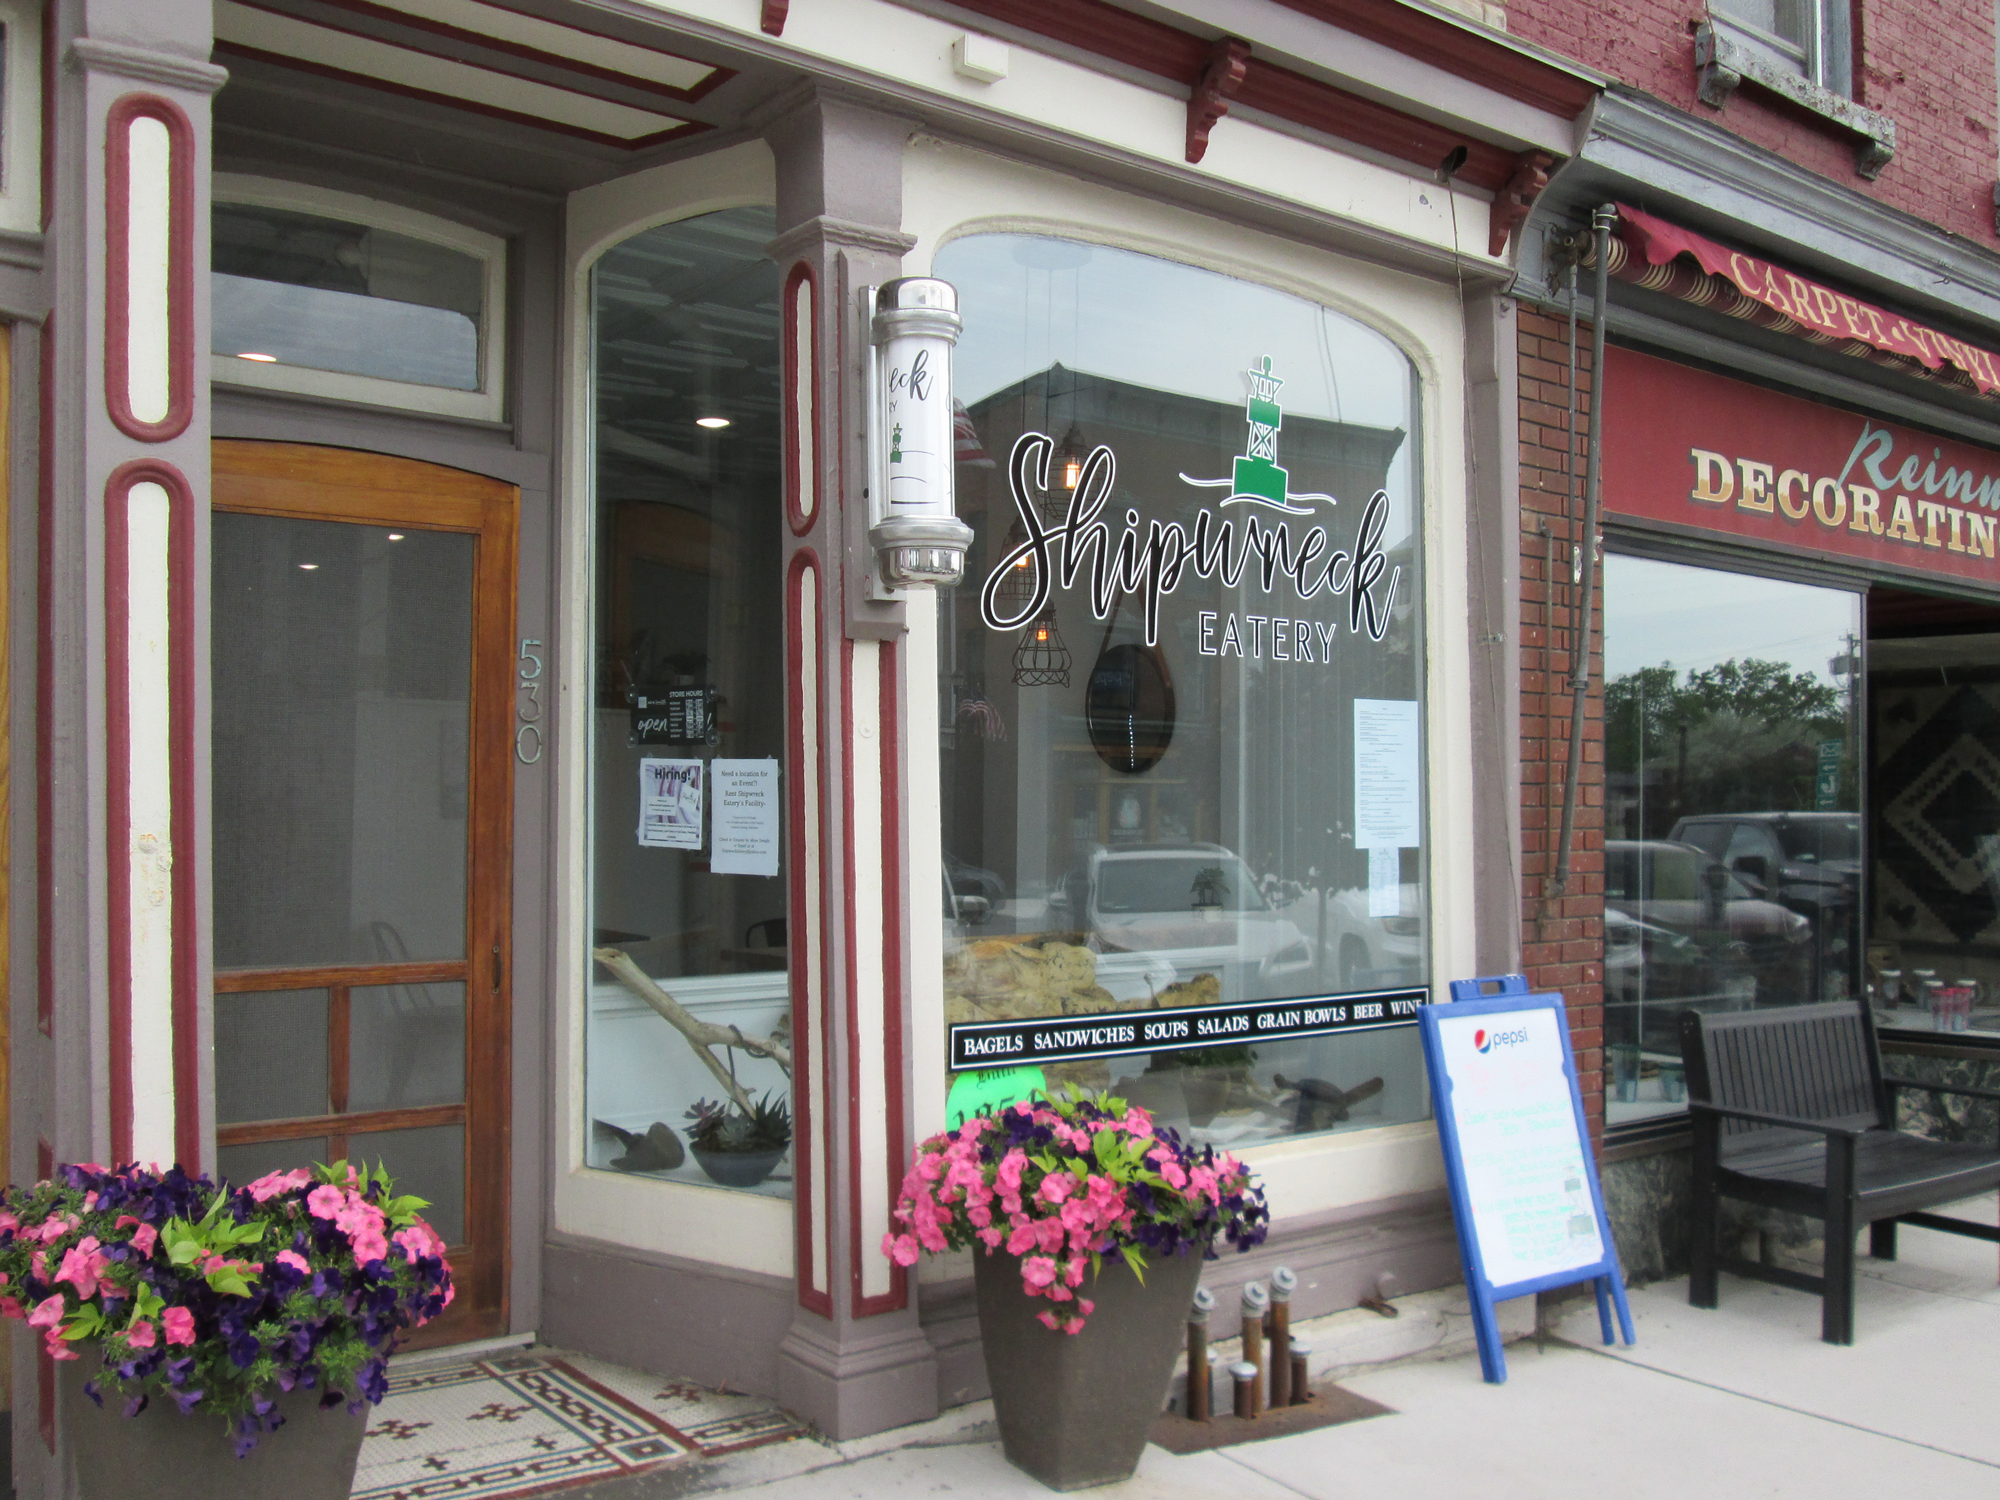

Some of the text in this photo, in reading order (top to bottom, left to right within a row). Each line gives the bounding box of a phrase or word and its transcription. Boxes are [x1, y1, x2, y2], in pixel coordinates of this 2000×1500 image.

[1730, 252, 1893, 346] CARPET
[1691, 447, 2000, 558] DECORATIN
[980, 431, 1400, 647] Shipwreck
[1198, 610, 1337, 664] EATERY
[515, 639, 543, 765] 530
[638, 718, 668, 739] open
[654, 767, 691, 783] Hiring!
[738, 790, 764, 798] Shipwreck
[723, 800, 744, 808] Eatery's
[963, 1034, 1024, 1056] BAGELS
[1034, 1025, 1135, 1050] SANDWICHES
[1145, 1020, 1188, 1040] SOUPS
[1197, 1015, 1250, 1035] SALADS
[1257, 1011, 1300, 1030] GRAIN
[1304, 1006, 1347, 1025] BOWLS
[1353, 1003, 1384, 1020] BEER
[1493, 1026, 1528, 1050] pepsi
